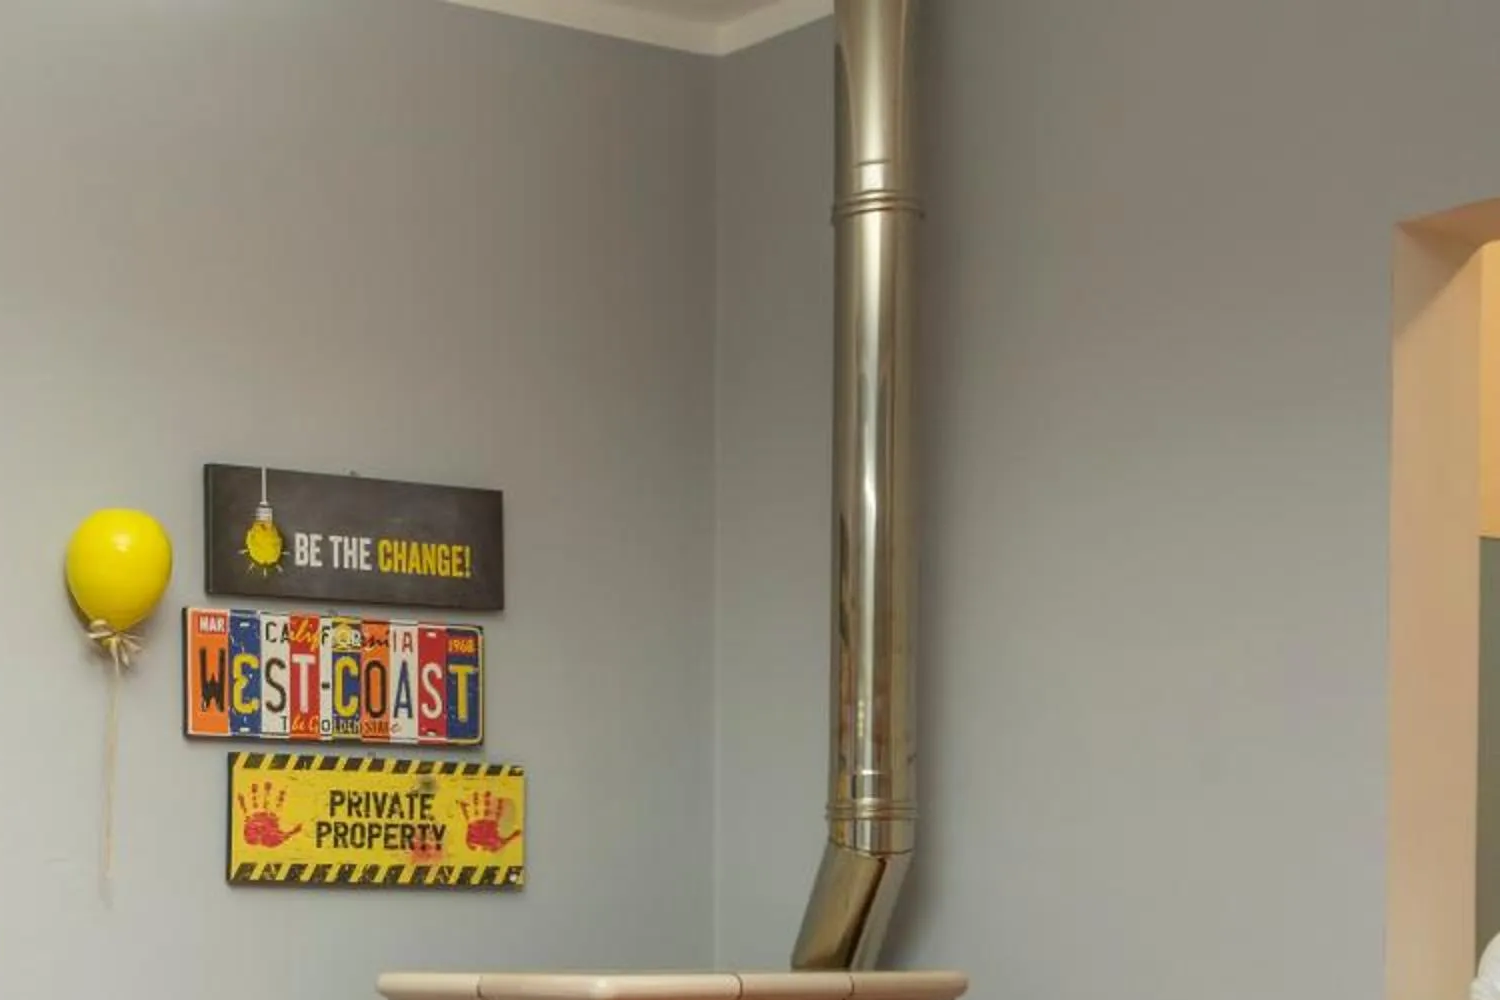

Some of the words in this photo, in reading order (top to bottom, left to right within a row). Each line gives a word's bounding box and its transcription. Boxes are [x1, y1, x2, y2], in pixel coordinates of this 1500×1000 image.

[294, 532, 323, 567] BE
[329, 534, 373, 571] THE
[377, 538, 472, 578] CHANGE!
[199, 616, 225, 632] MAR
[328, 789, 436, 822] PRIVATE
[315, 821, 447, 852] PROPERTY
